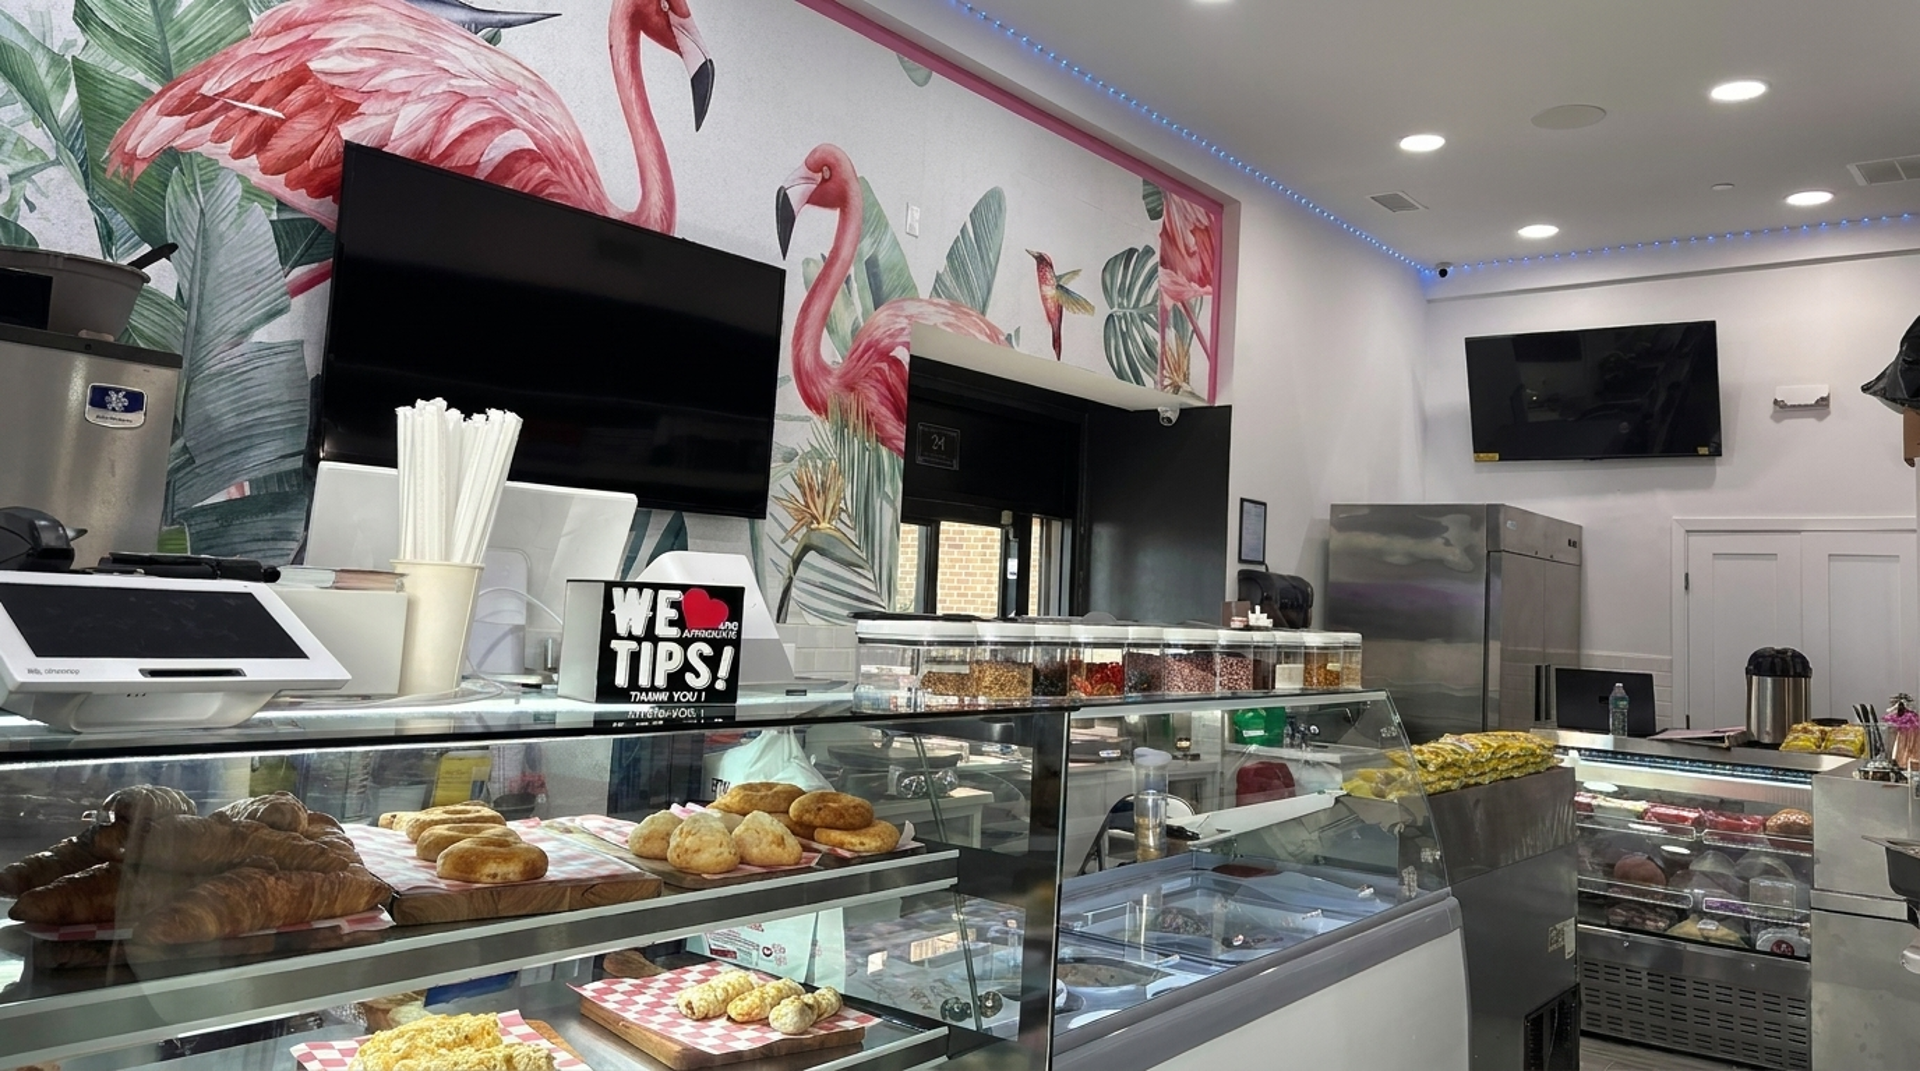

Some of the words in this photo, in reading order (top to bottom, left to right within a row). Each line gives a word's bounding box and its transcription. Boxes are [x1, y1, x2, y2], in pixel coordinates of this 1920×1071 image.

[611, 587, 684, 638] WE
[610, 640, 735, 691] TIPS!
[672, 691, 698, 702] YOU
